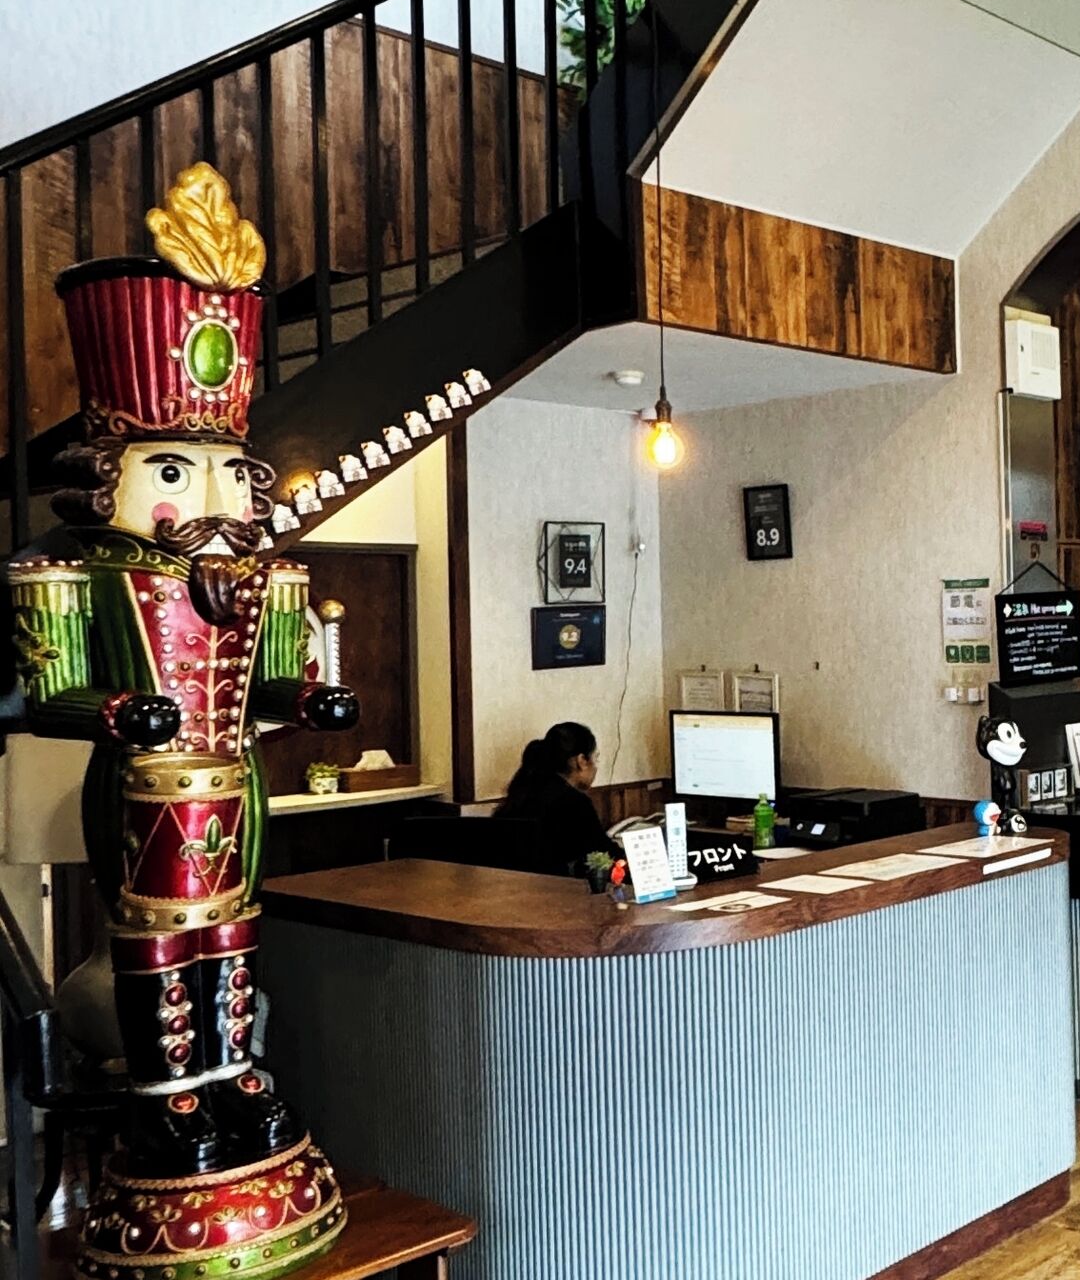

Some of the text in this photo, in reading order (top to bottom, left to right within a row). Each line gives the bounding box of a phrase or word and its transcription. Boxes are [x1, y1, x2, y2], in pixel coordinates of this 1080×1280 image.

[756, 527, 780, 547] 8.9
[564, 557, 587, 575] 9.4
[687, 843, 747, 867] フロント
